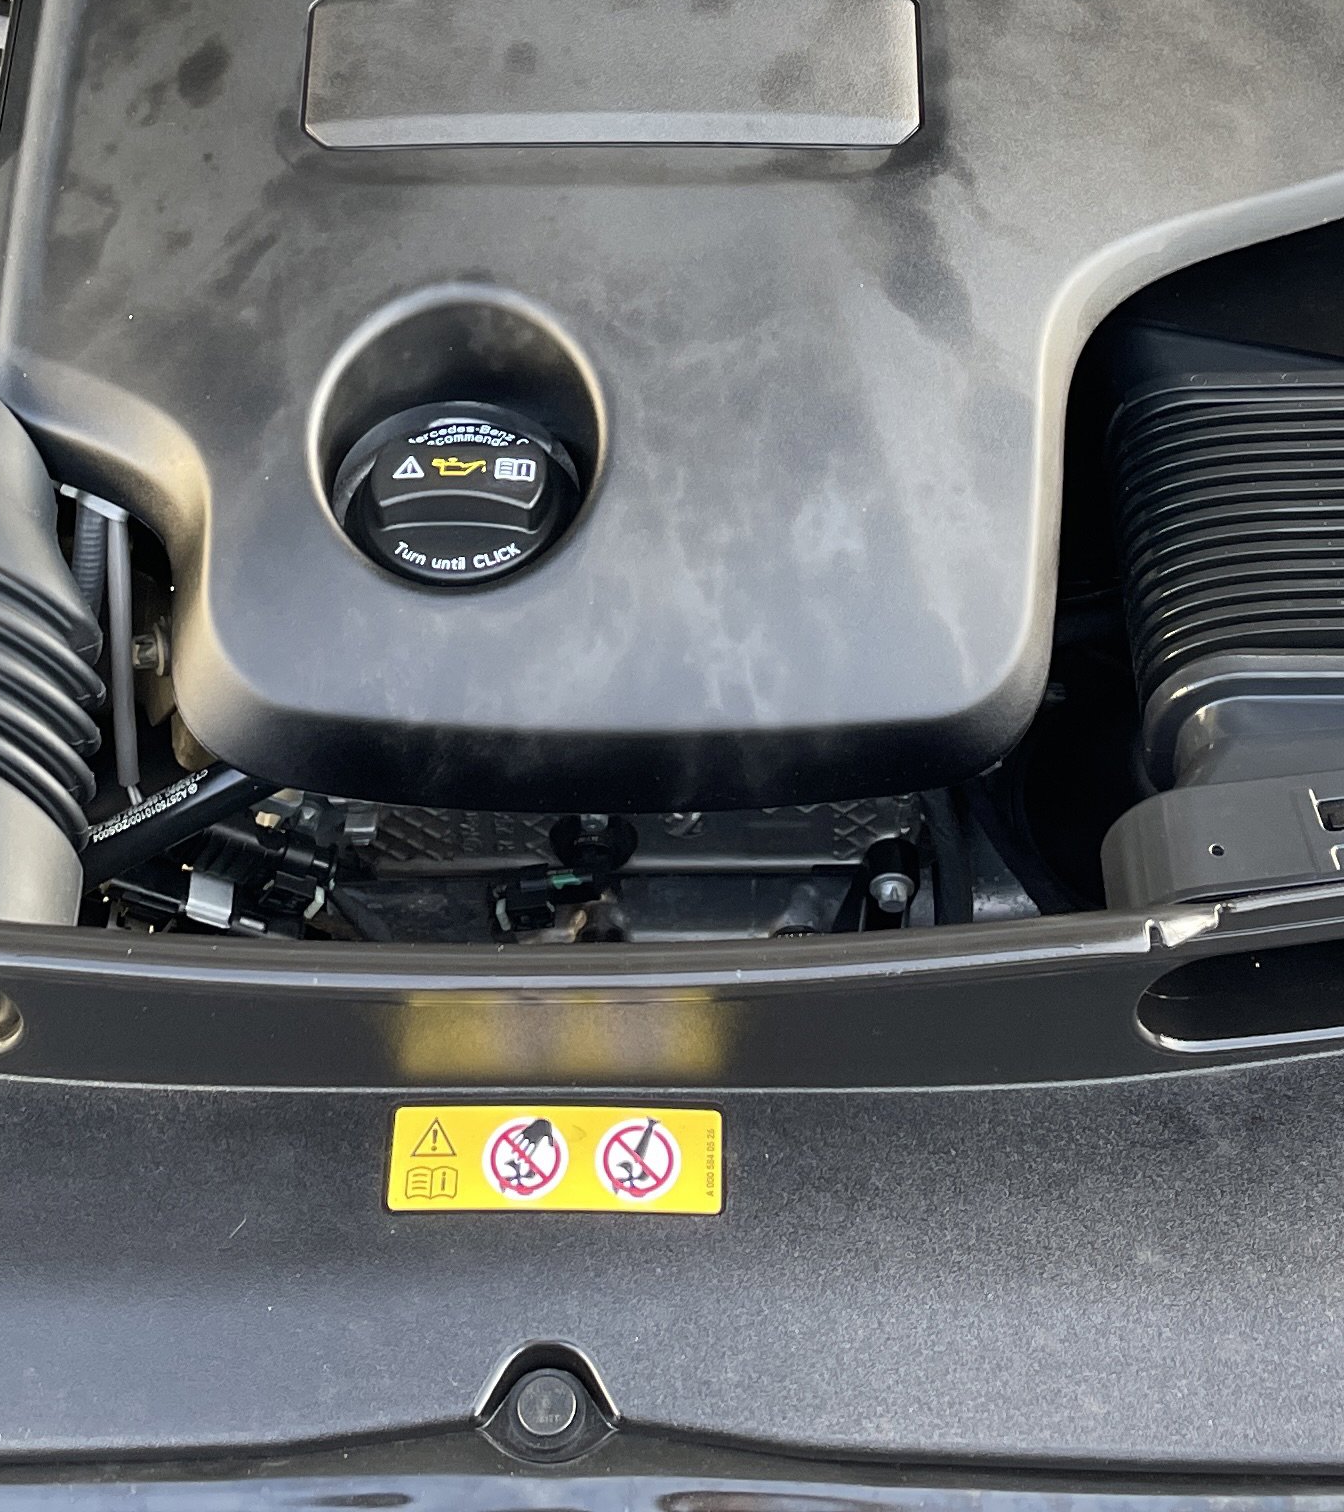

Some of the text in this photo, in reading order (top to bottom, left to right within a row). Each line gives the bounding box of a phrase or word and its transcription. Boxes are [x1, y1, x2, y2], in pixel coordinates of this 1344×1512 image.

[394, 541, 522, 571] Turn until CLICK
